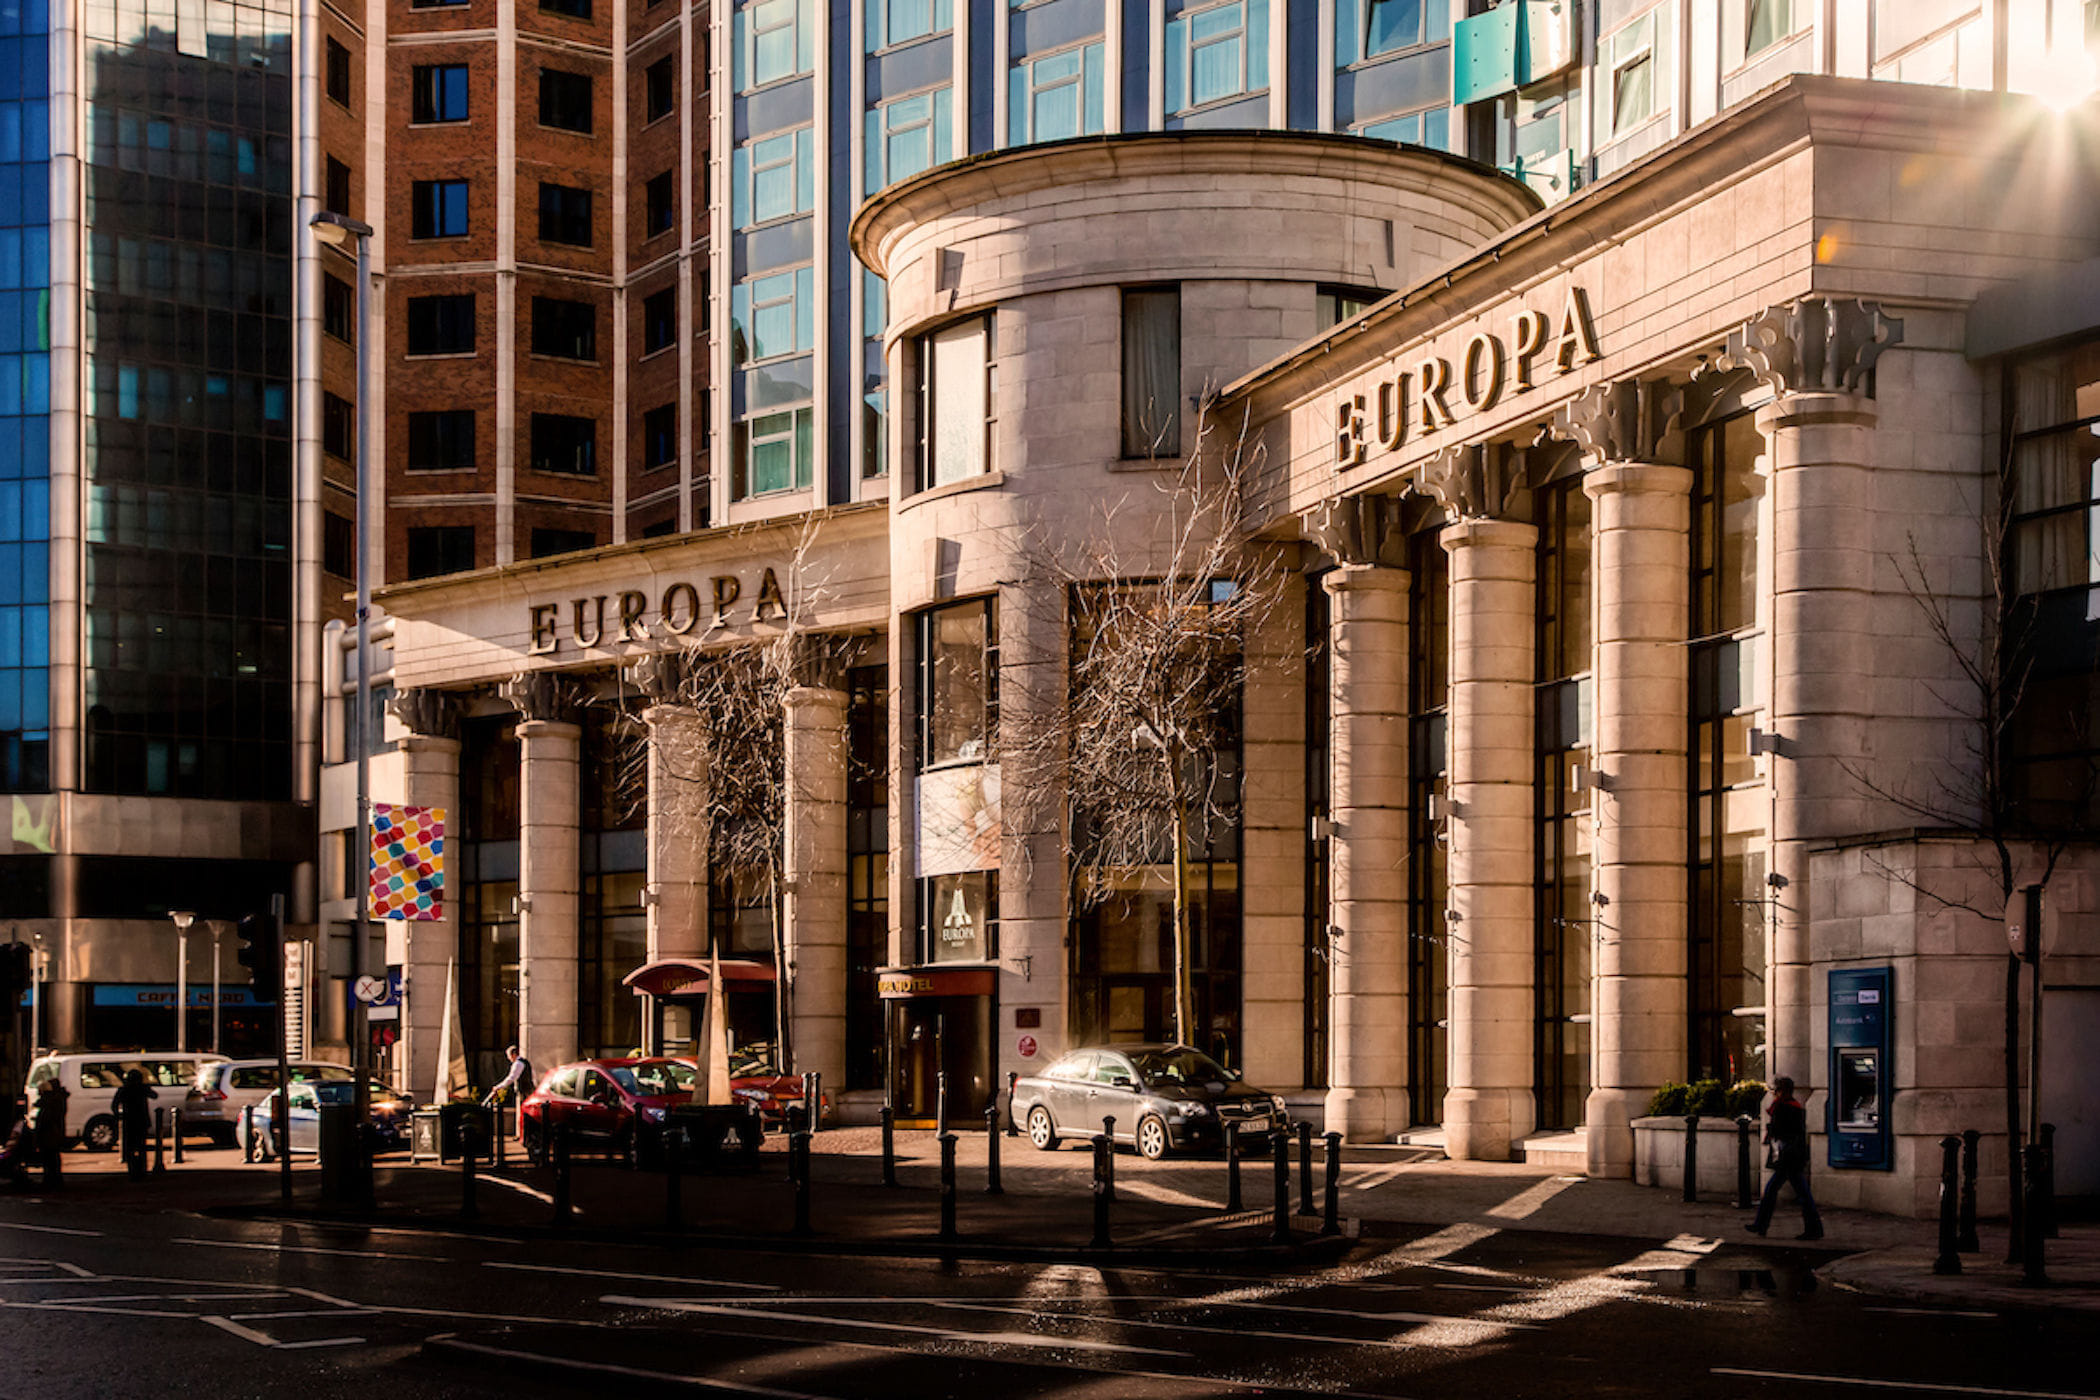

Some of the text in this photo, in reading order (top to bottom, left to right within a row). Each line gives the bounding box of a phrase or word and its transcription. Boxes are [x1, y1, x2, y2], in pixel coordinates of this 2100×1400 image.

[1334, 286, 1601, 473] EUROPA
[527, 566, 788, 657] EUROPA
[942, 928, 976, 942] EUROPA
[198, 991, 245, 1004] NRO
